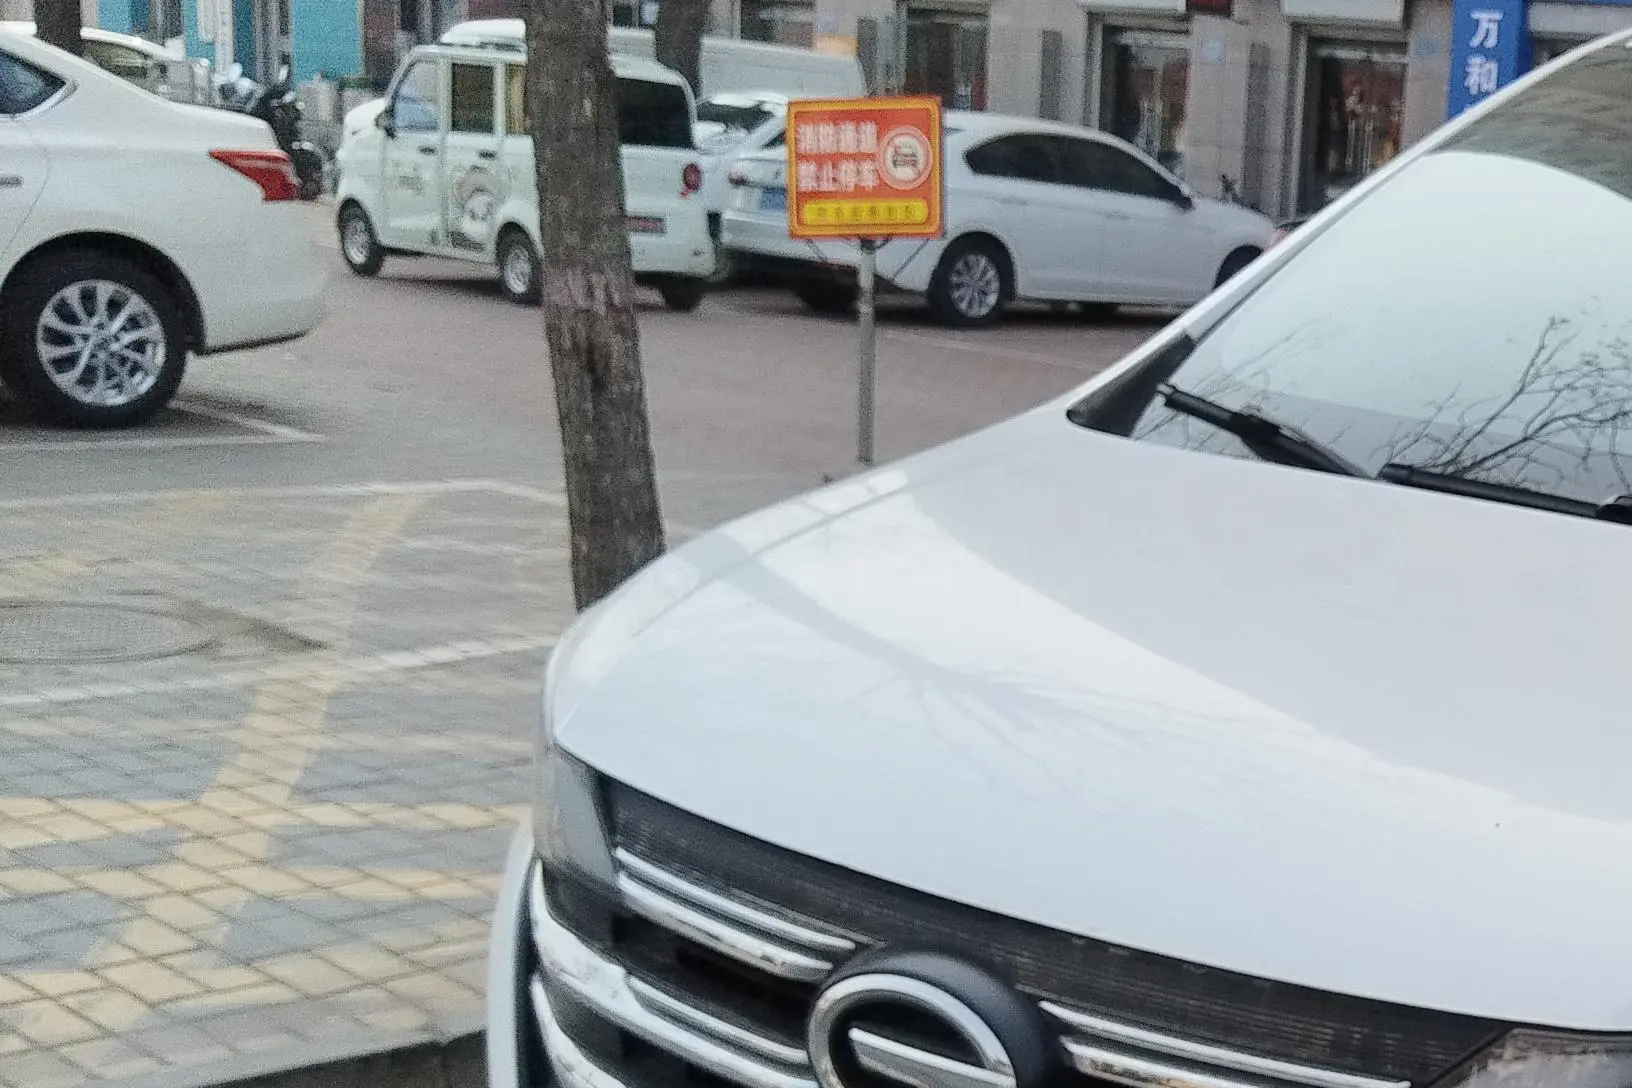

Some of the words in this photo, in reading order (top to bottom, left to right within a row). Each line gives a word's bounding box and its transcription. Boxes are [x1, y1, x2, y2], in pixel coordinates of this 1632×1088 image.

[1464, 9, 1503, 95] 万和
[797, 160, 879, 191] 禁止停车
